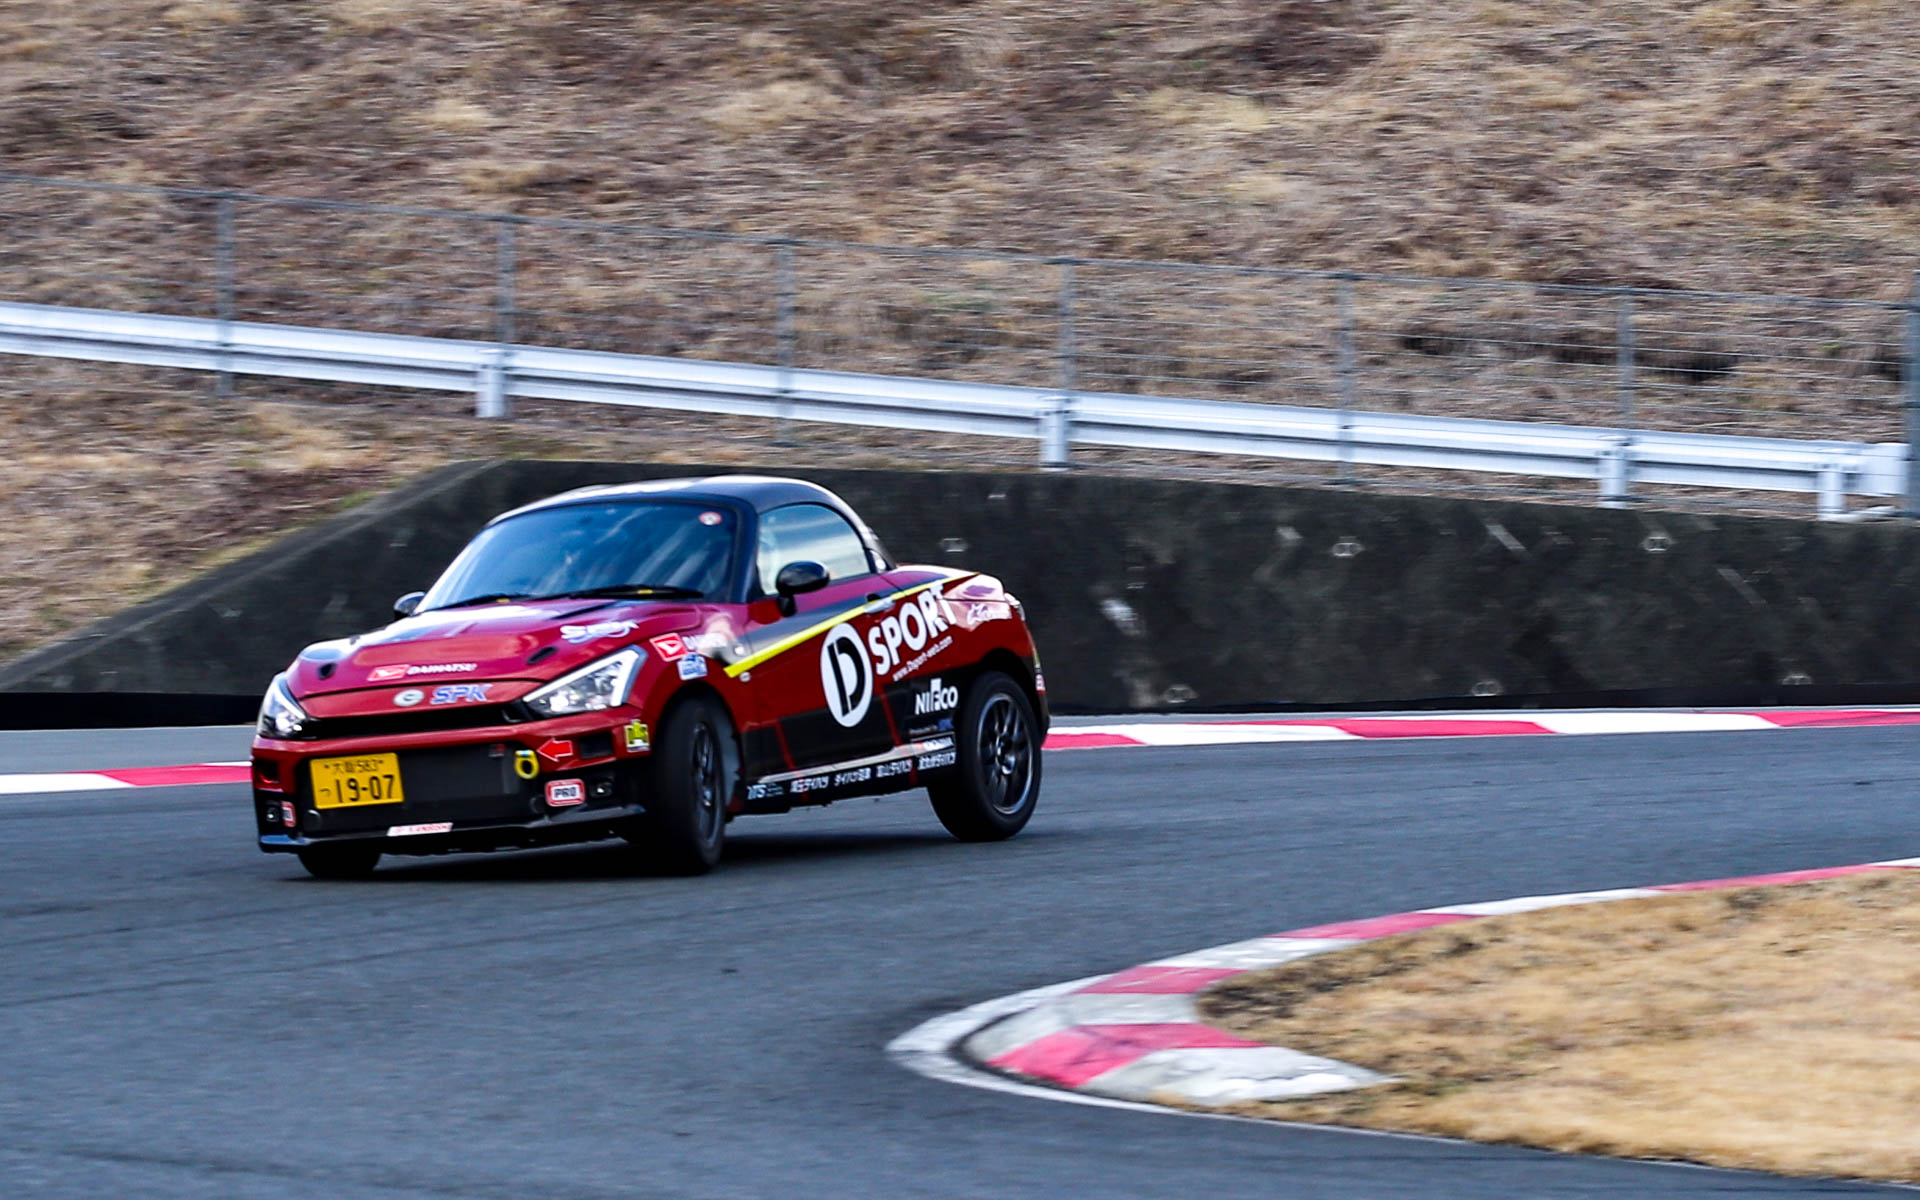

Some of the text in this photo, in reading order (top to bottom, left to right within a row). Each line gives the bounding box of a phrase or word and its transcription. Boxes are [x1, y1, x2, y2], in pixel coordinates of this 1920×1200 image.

[868, 581, 957, 675] SPORT
[430, 683, 493, 704] SPK
[335, 774, 395, 803] 19-07
